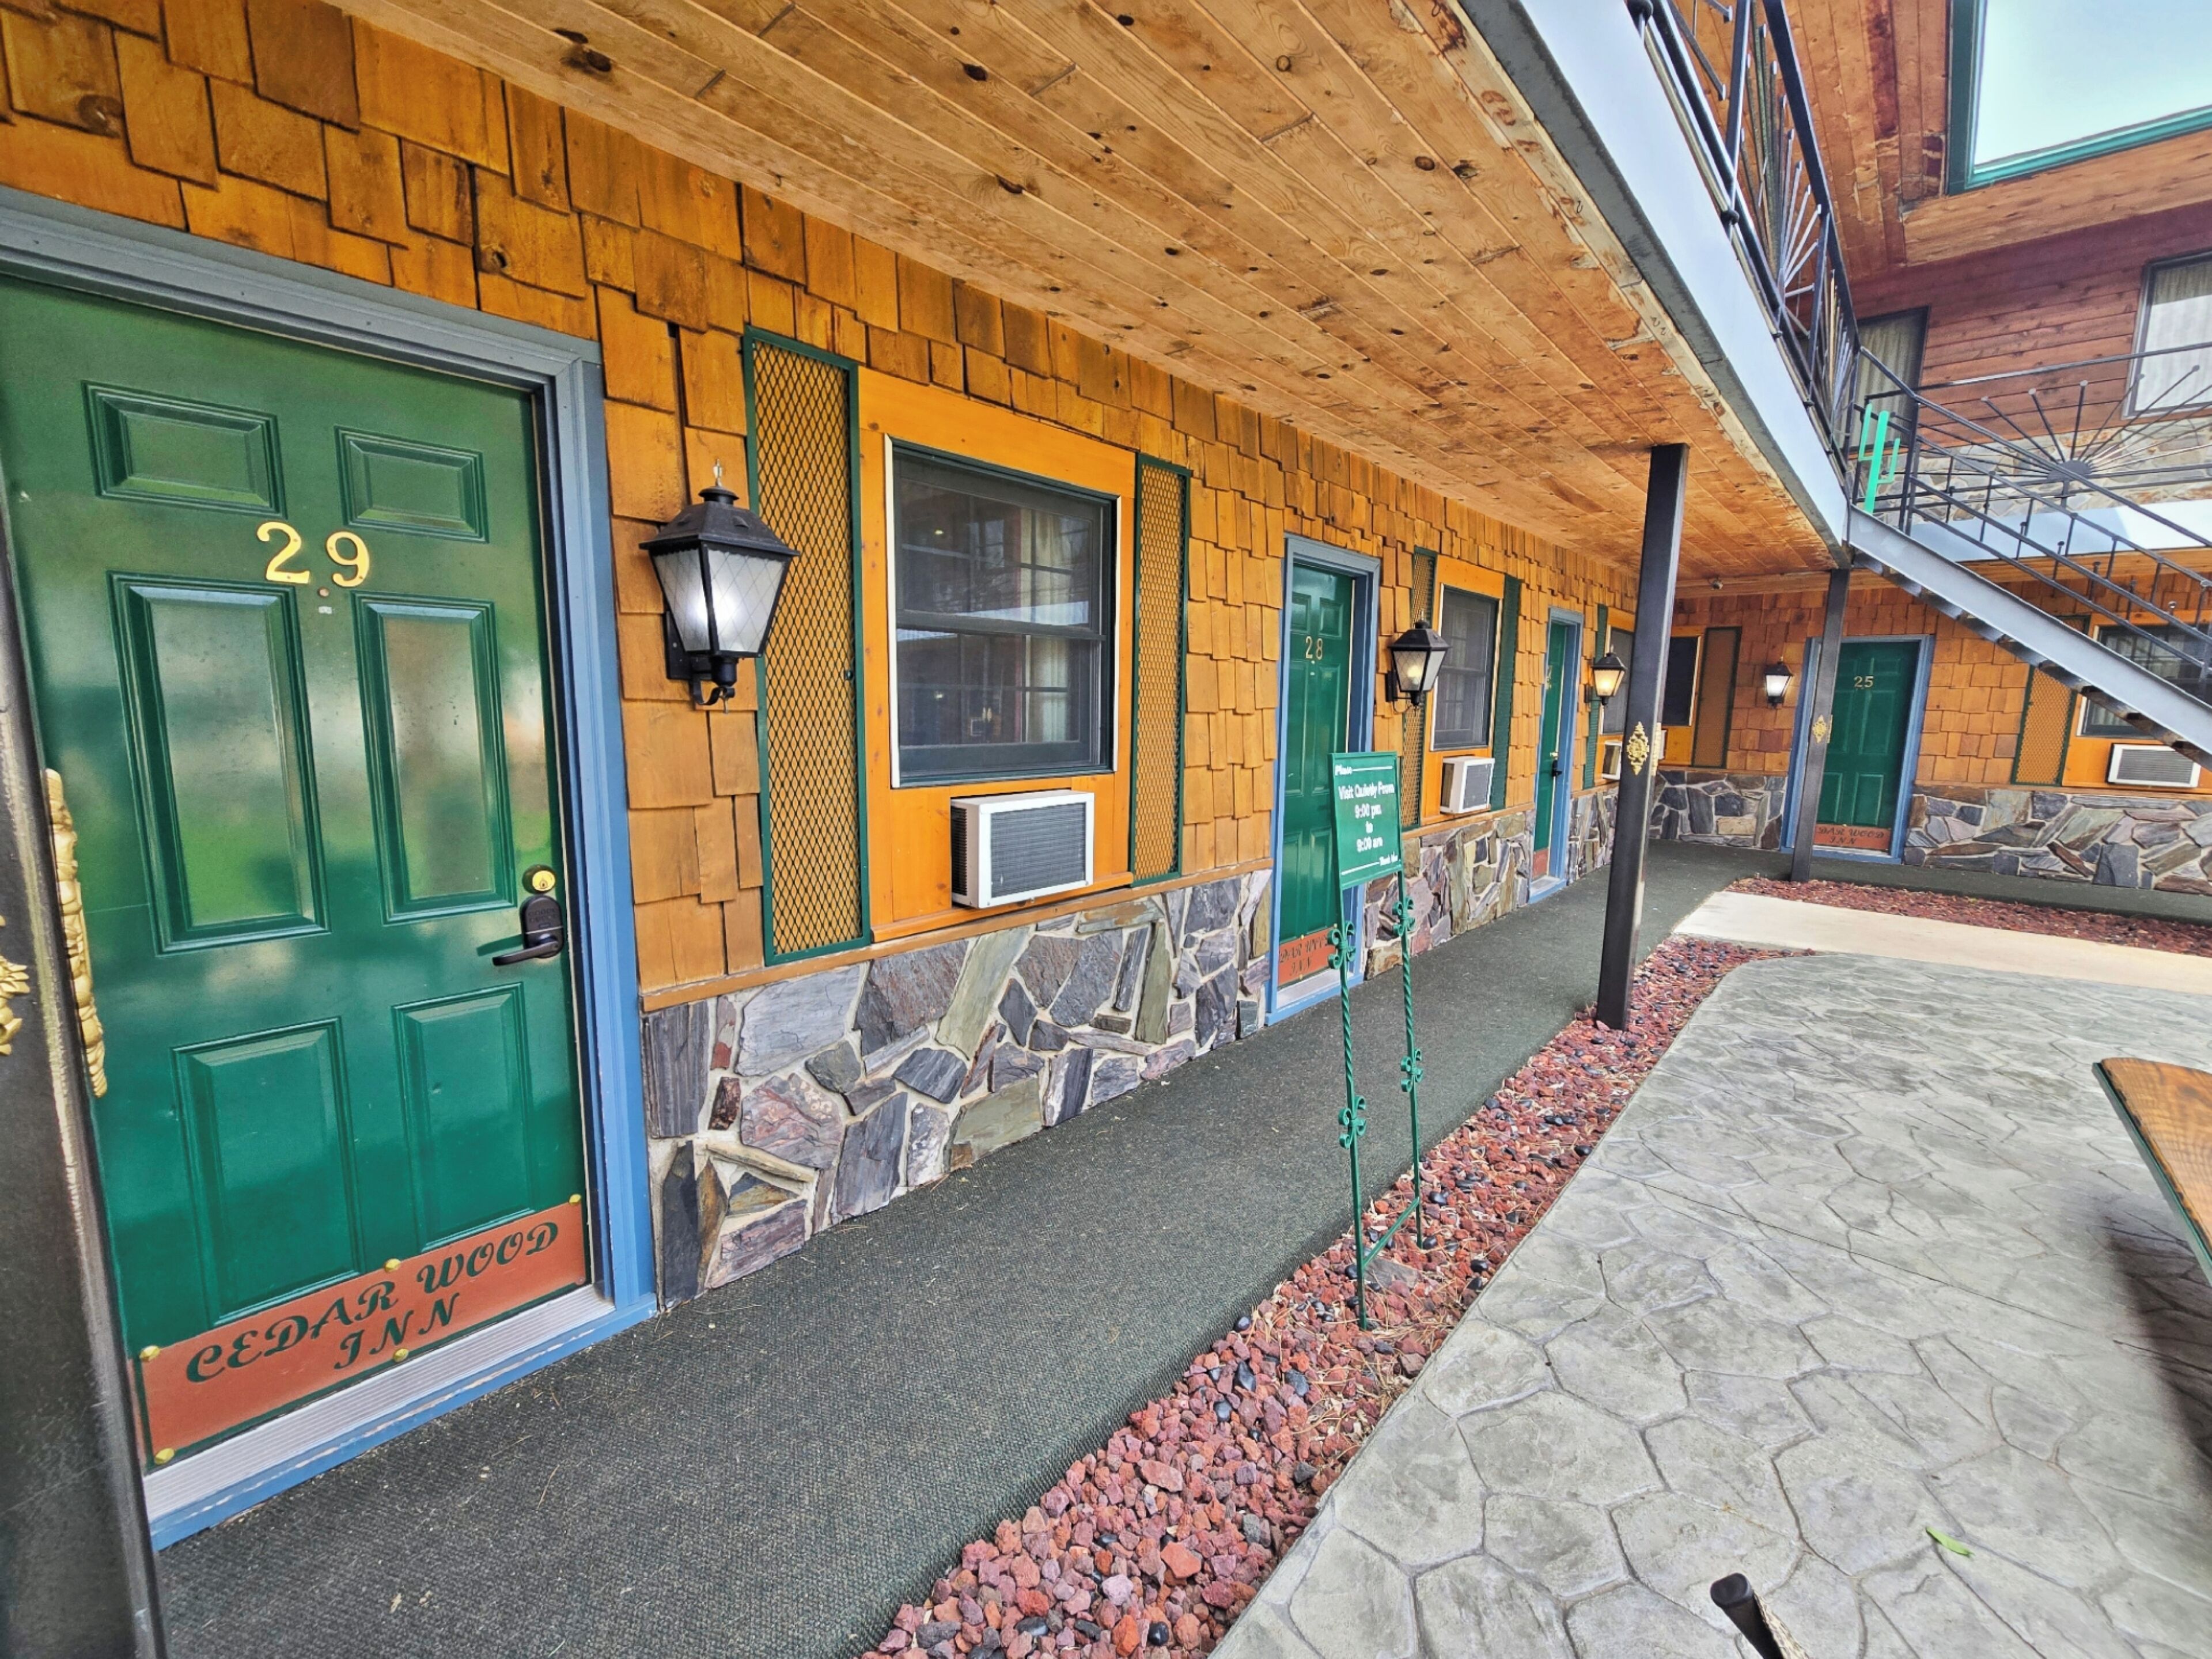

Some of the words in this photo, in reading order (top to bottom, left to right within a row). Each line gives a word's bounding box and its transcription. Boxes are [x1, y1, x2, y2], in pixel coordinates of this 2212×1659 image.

[257, 521, 370, 587] 29
[1305, 636, 1323, 660] 28
[1854, 676, 1874, 688] 25
[1338, 785, 1354, 800] Visit
[1354, 782, 1377, 798] Quietly
[1378, 781, 1395, 795] From
[1365, 820, 1373, 834] to
[186, 1279, 397, 1382] CEDAR
[416, 1221, 558, 1294] WOOD
[334, 1293, 460, 1370] INN
